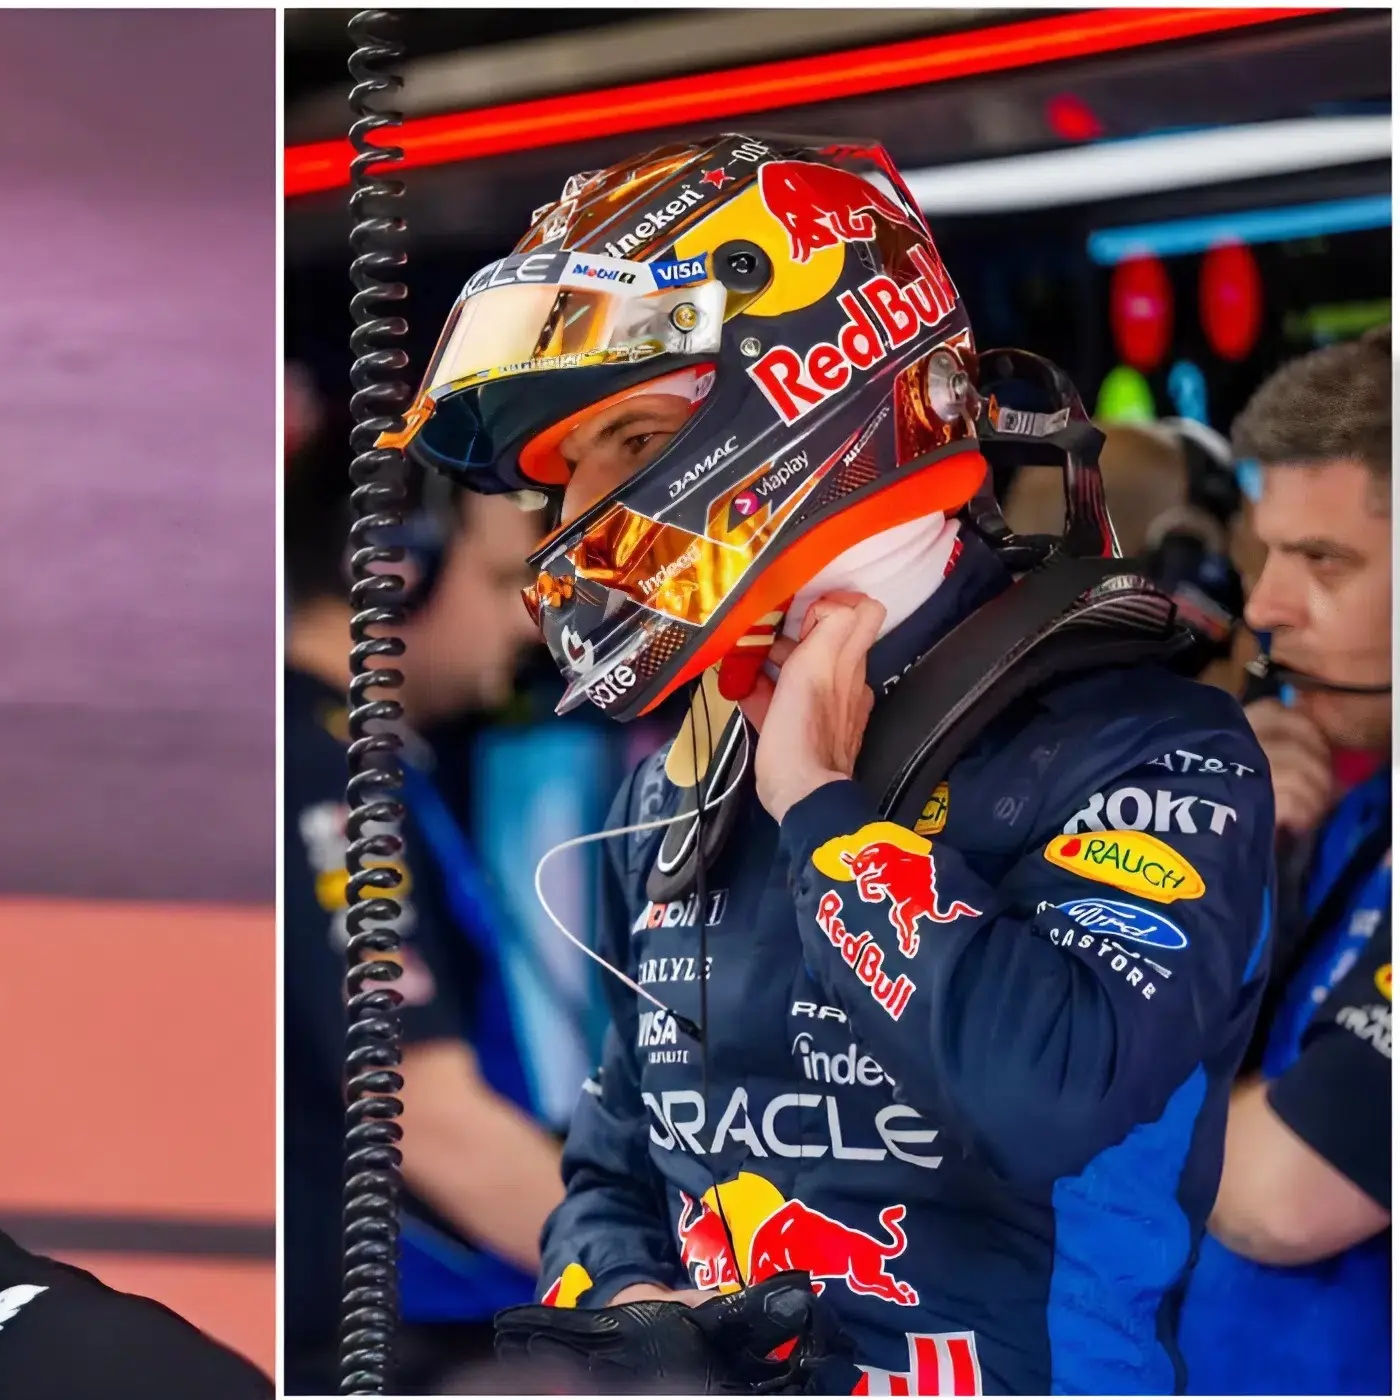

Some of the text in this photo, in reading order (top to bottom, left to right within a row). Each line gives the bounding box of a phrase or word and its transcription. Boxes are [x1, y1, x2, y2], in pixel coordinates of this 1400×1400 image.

[657, 261, 706, 285] VISA
[747, 289, 888, 427] Red
[1084, 839, 1185, 889] RAUCH
[1050, 928, 1158, 1000] CASTORE
